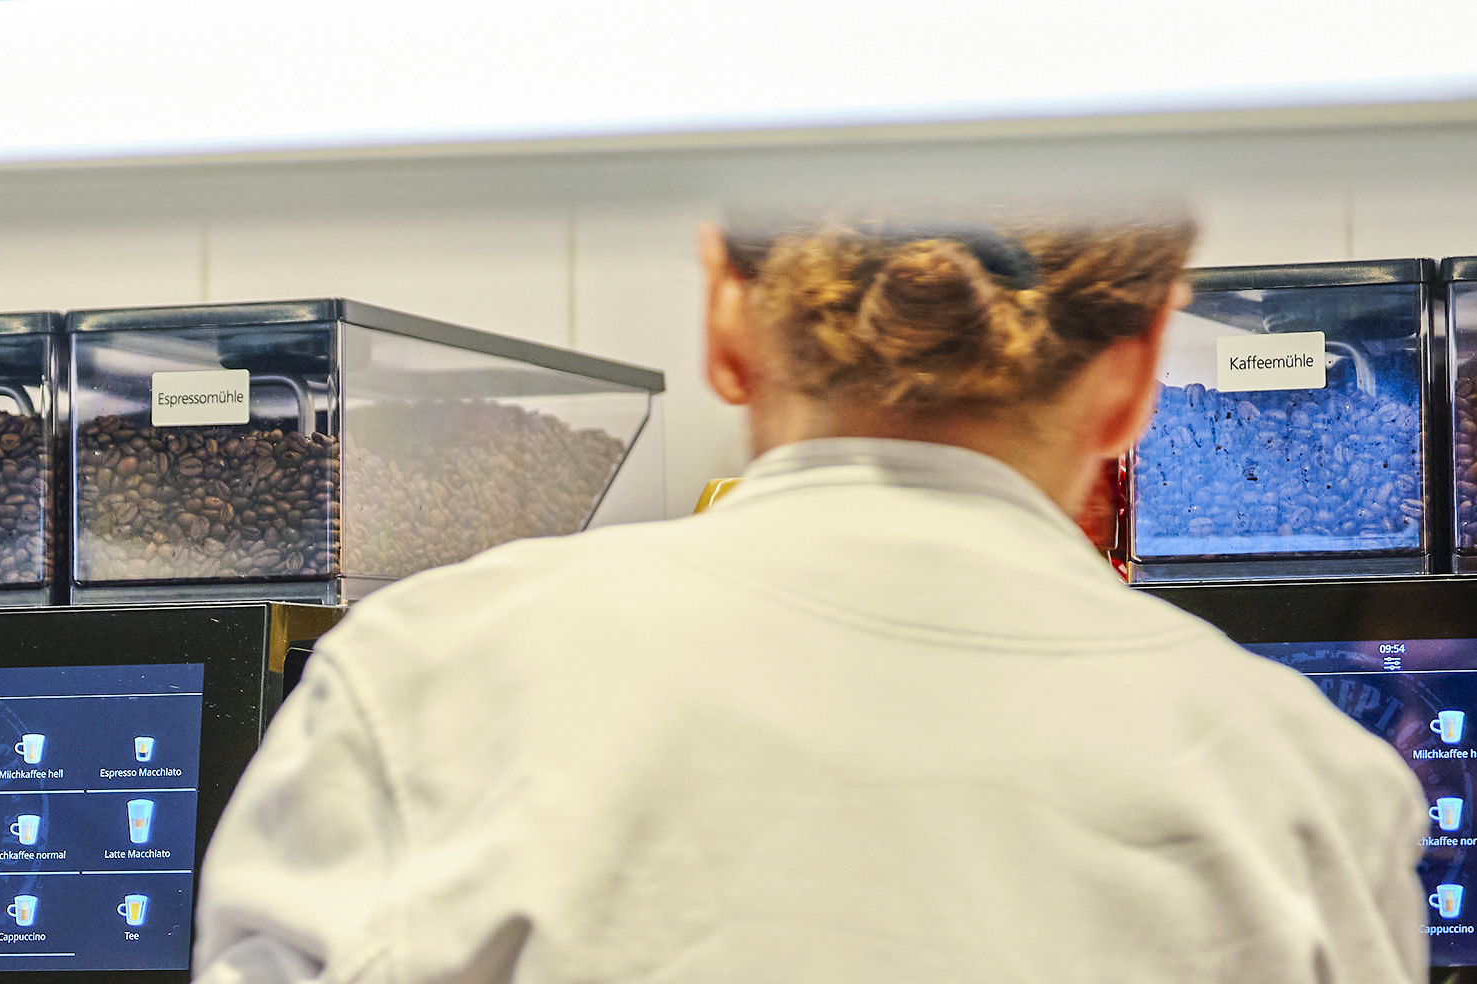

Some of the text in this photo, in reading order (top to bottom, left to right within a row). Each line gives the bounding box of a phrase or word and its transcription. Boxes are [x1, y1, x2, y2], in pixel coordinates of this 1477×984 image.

[1229, 353, 1314, 371] Kaffeemühle
[157, 388, 244, 407] Espressomühle
[1379, 643, 1406, 655] 09:54
[1412, 748, 1470, 761] Milchkaffee
[47, 768, 65, 779] hell
[99, 766, 183, 781] Espresso Macchiato
[1417, 836, 1459, 847] chkaffee
[36, 849, 67, 860] normal
[104, 848, 172, 860] Latte Macchiato
[1418, 923, 1476, 936] Cappuccino
[123, 931, 140, 942] Tee
